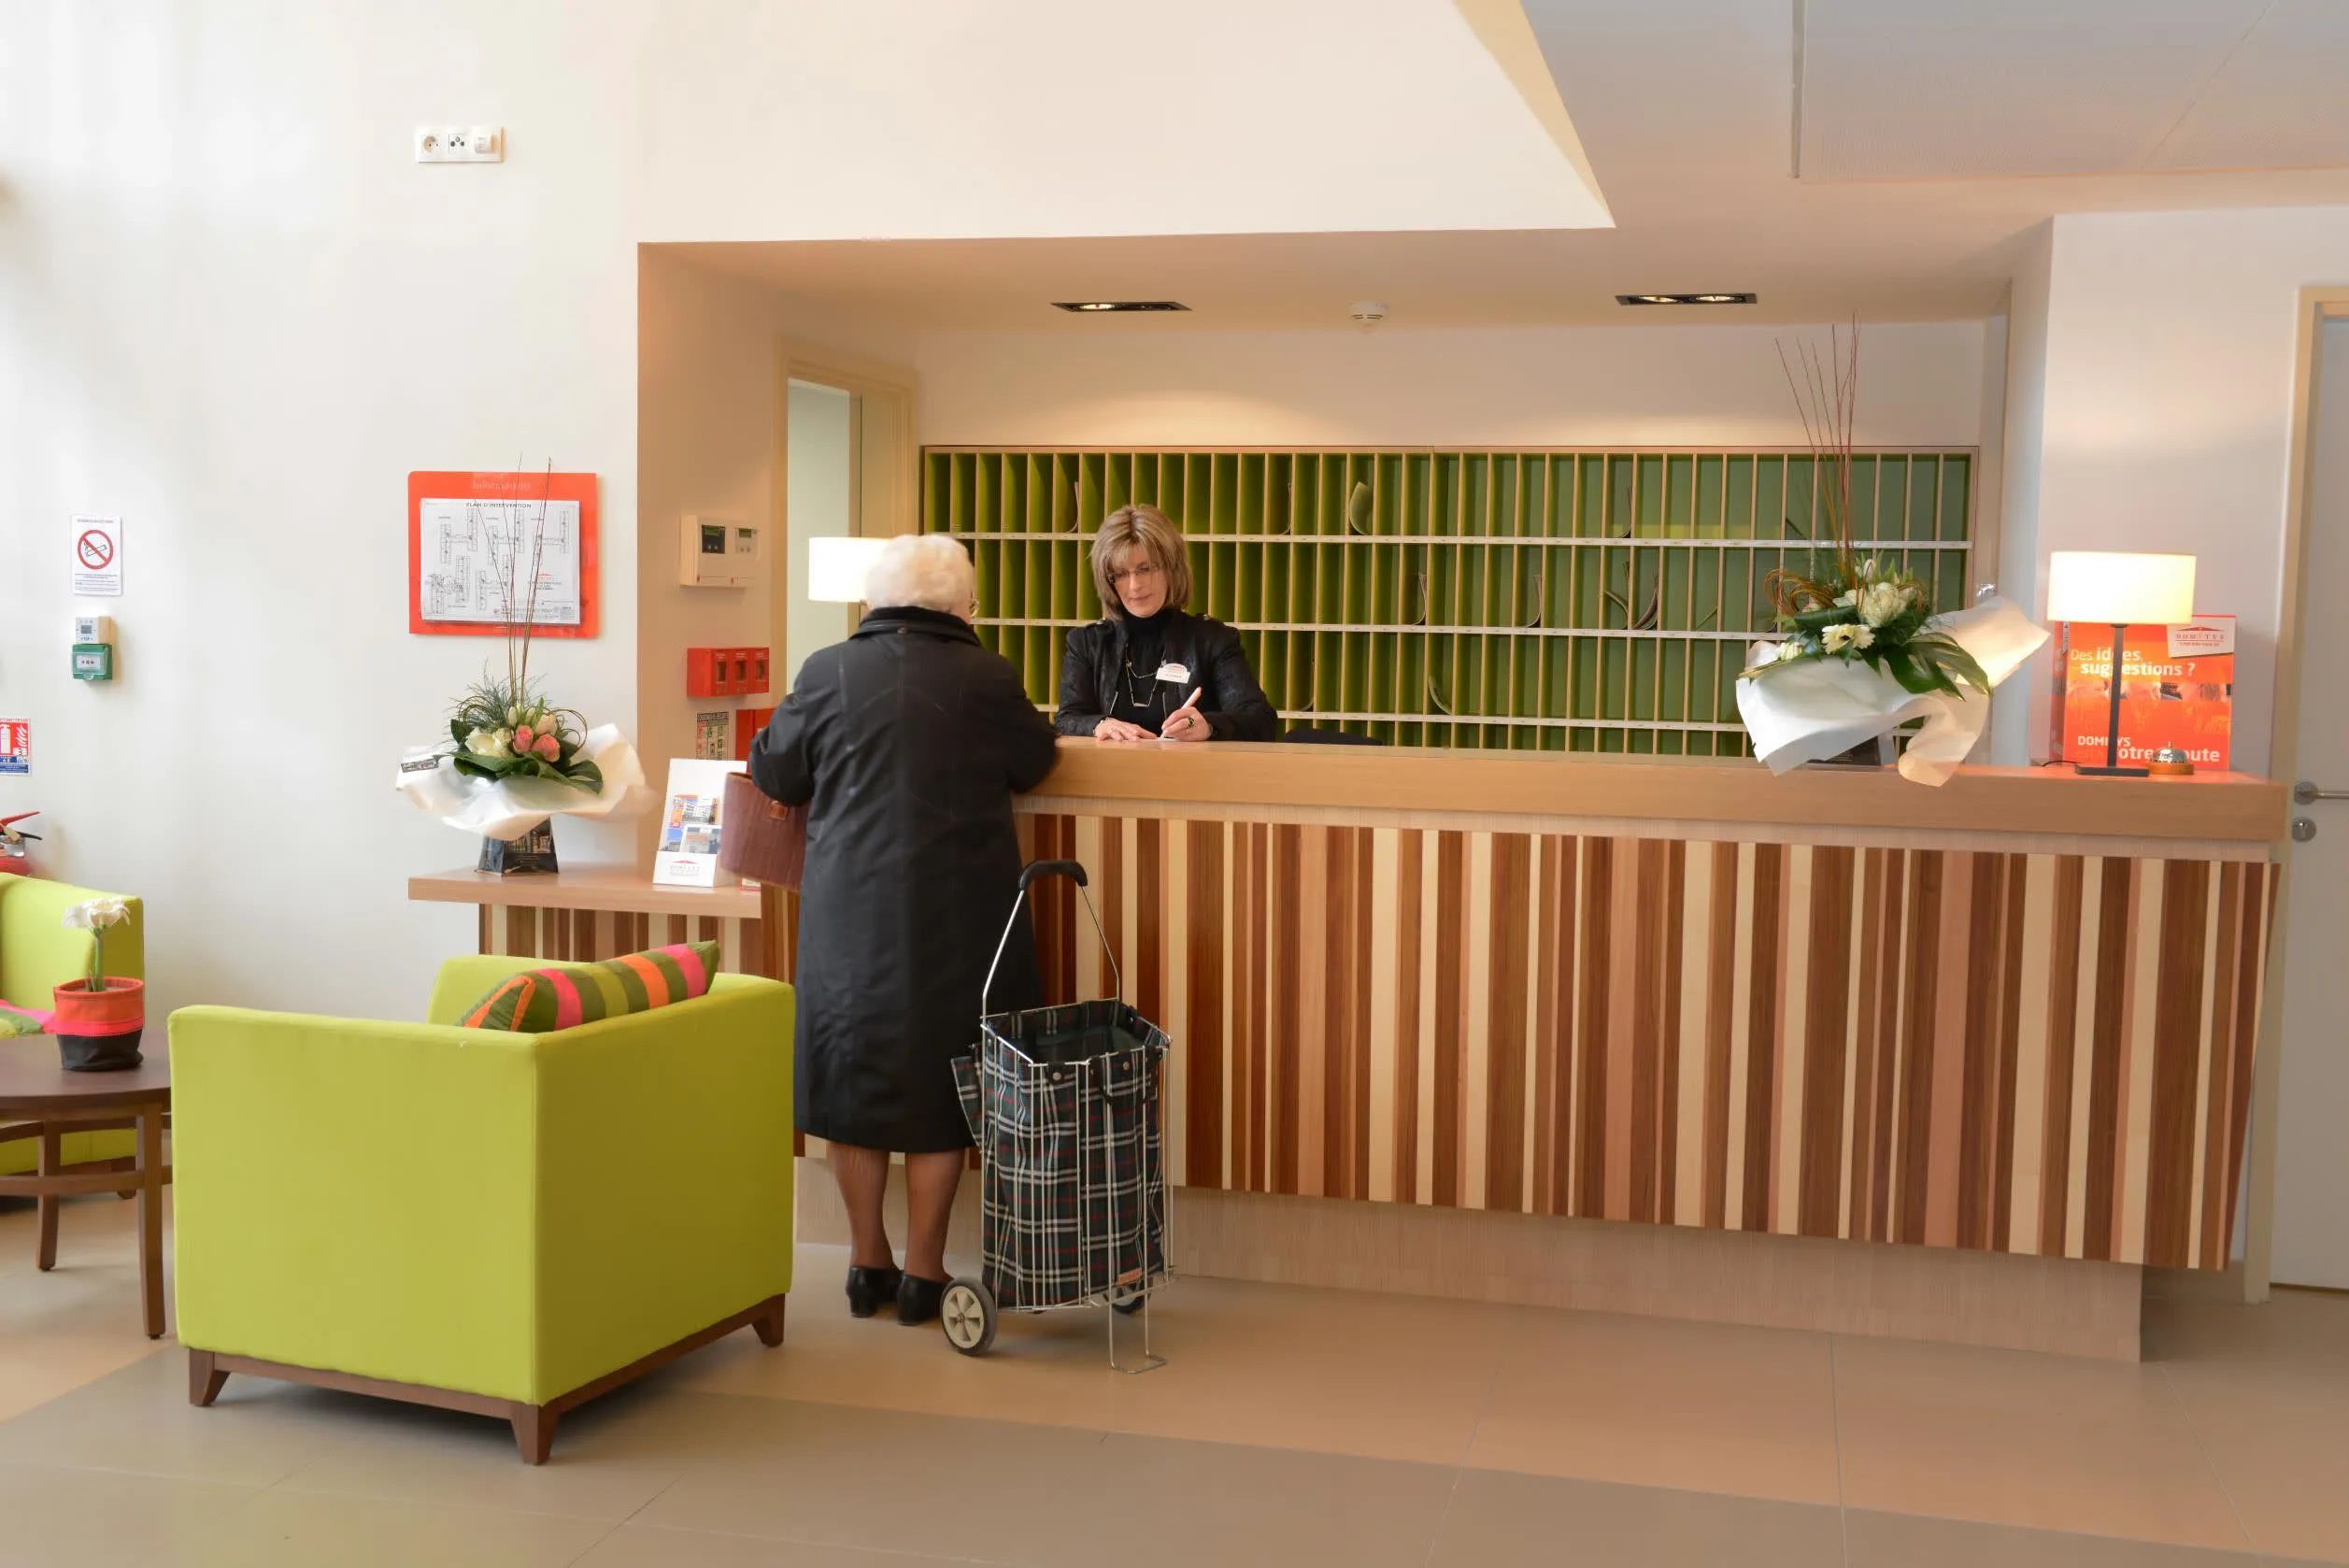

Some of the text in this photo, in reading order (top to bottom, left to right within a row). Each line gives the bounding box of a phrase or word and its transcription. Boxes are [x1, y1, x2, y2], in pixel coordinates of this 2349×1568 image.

[2070, 647, 2144, 663] Des ides,
[2081, 663, 2196, 677] sugestions ?
[2077, 736, 2130, 747] DOMIYS
[2118, 747, 2153, 760] otre
